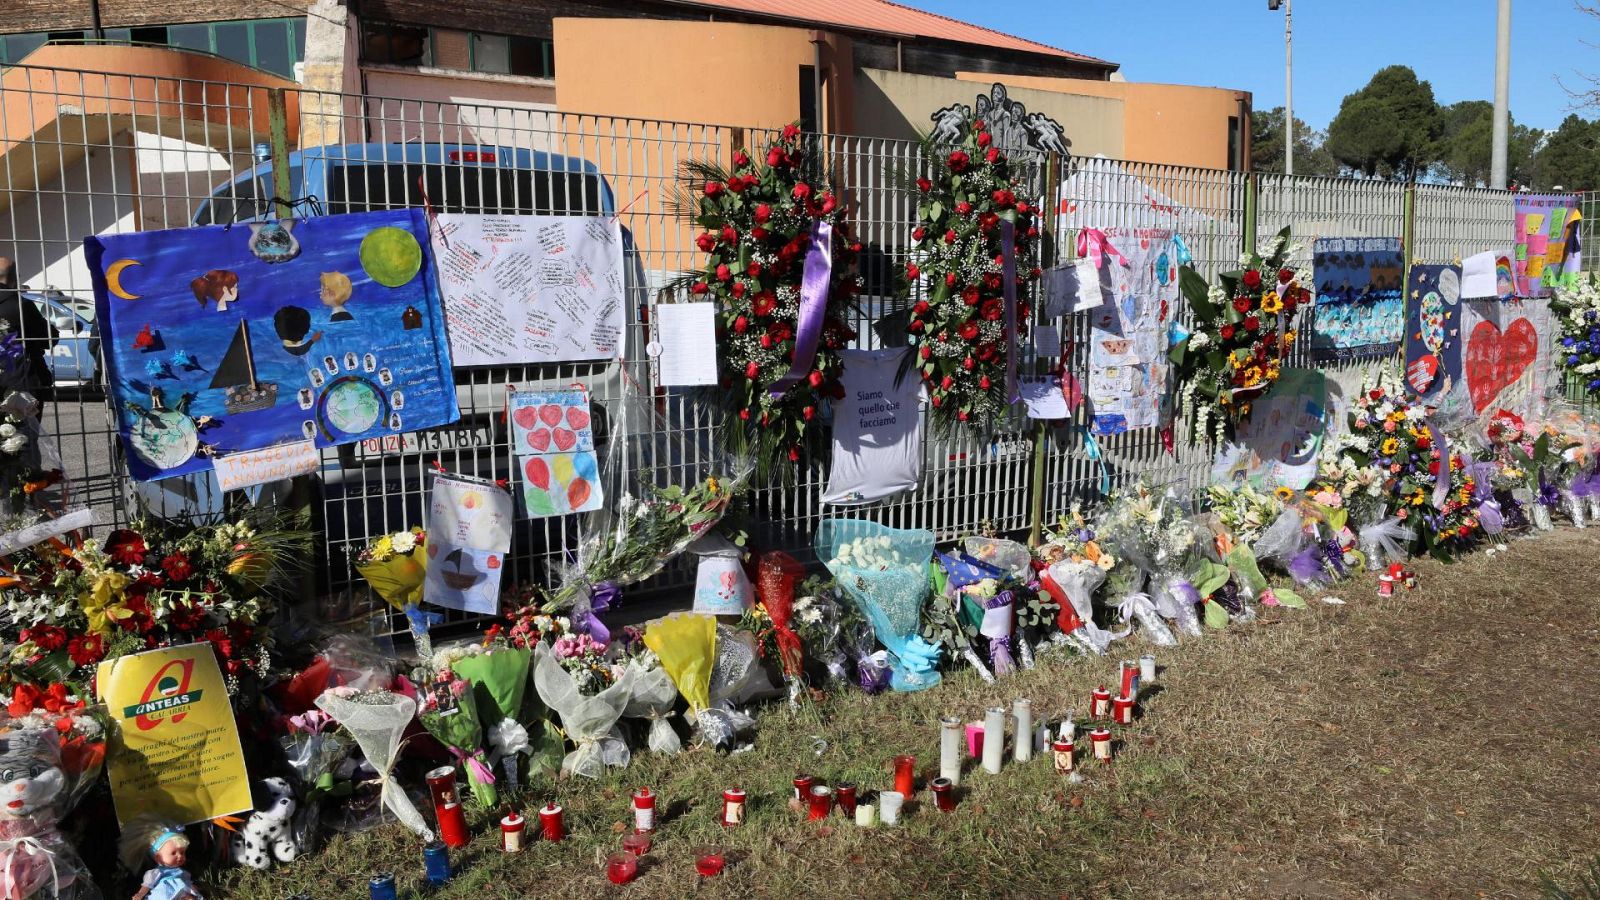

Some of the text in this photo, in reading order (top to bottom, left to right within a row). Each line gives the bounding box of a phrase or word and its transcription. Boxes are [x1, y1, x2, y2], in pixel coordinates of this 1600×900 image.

[857, 391, 883, 401] Siamo
[859, 401, 900, 416] quello che
[860, 416, 896, 428] facciamo
[361, 435, 409, 453] POLIZIA
[224, 443, 312, 470] TRAGEDIA
[150, 705, 191, 720] CALABRIA
[170, 735, 179, 746] del
[181, 731, 204, 742] nostro
[208, 737, 221, 746] con
[196, 756, 212, 766] loro
